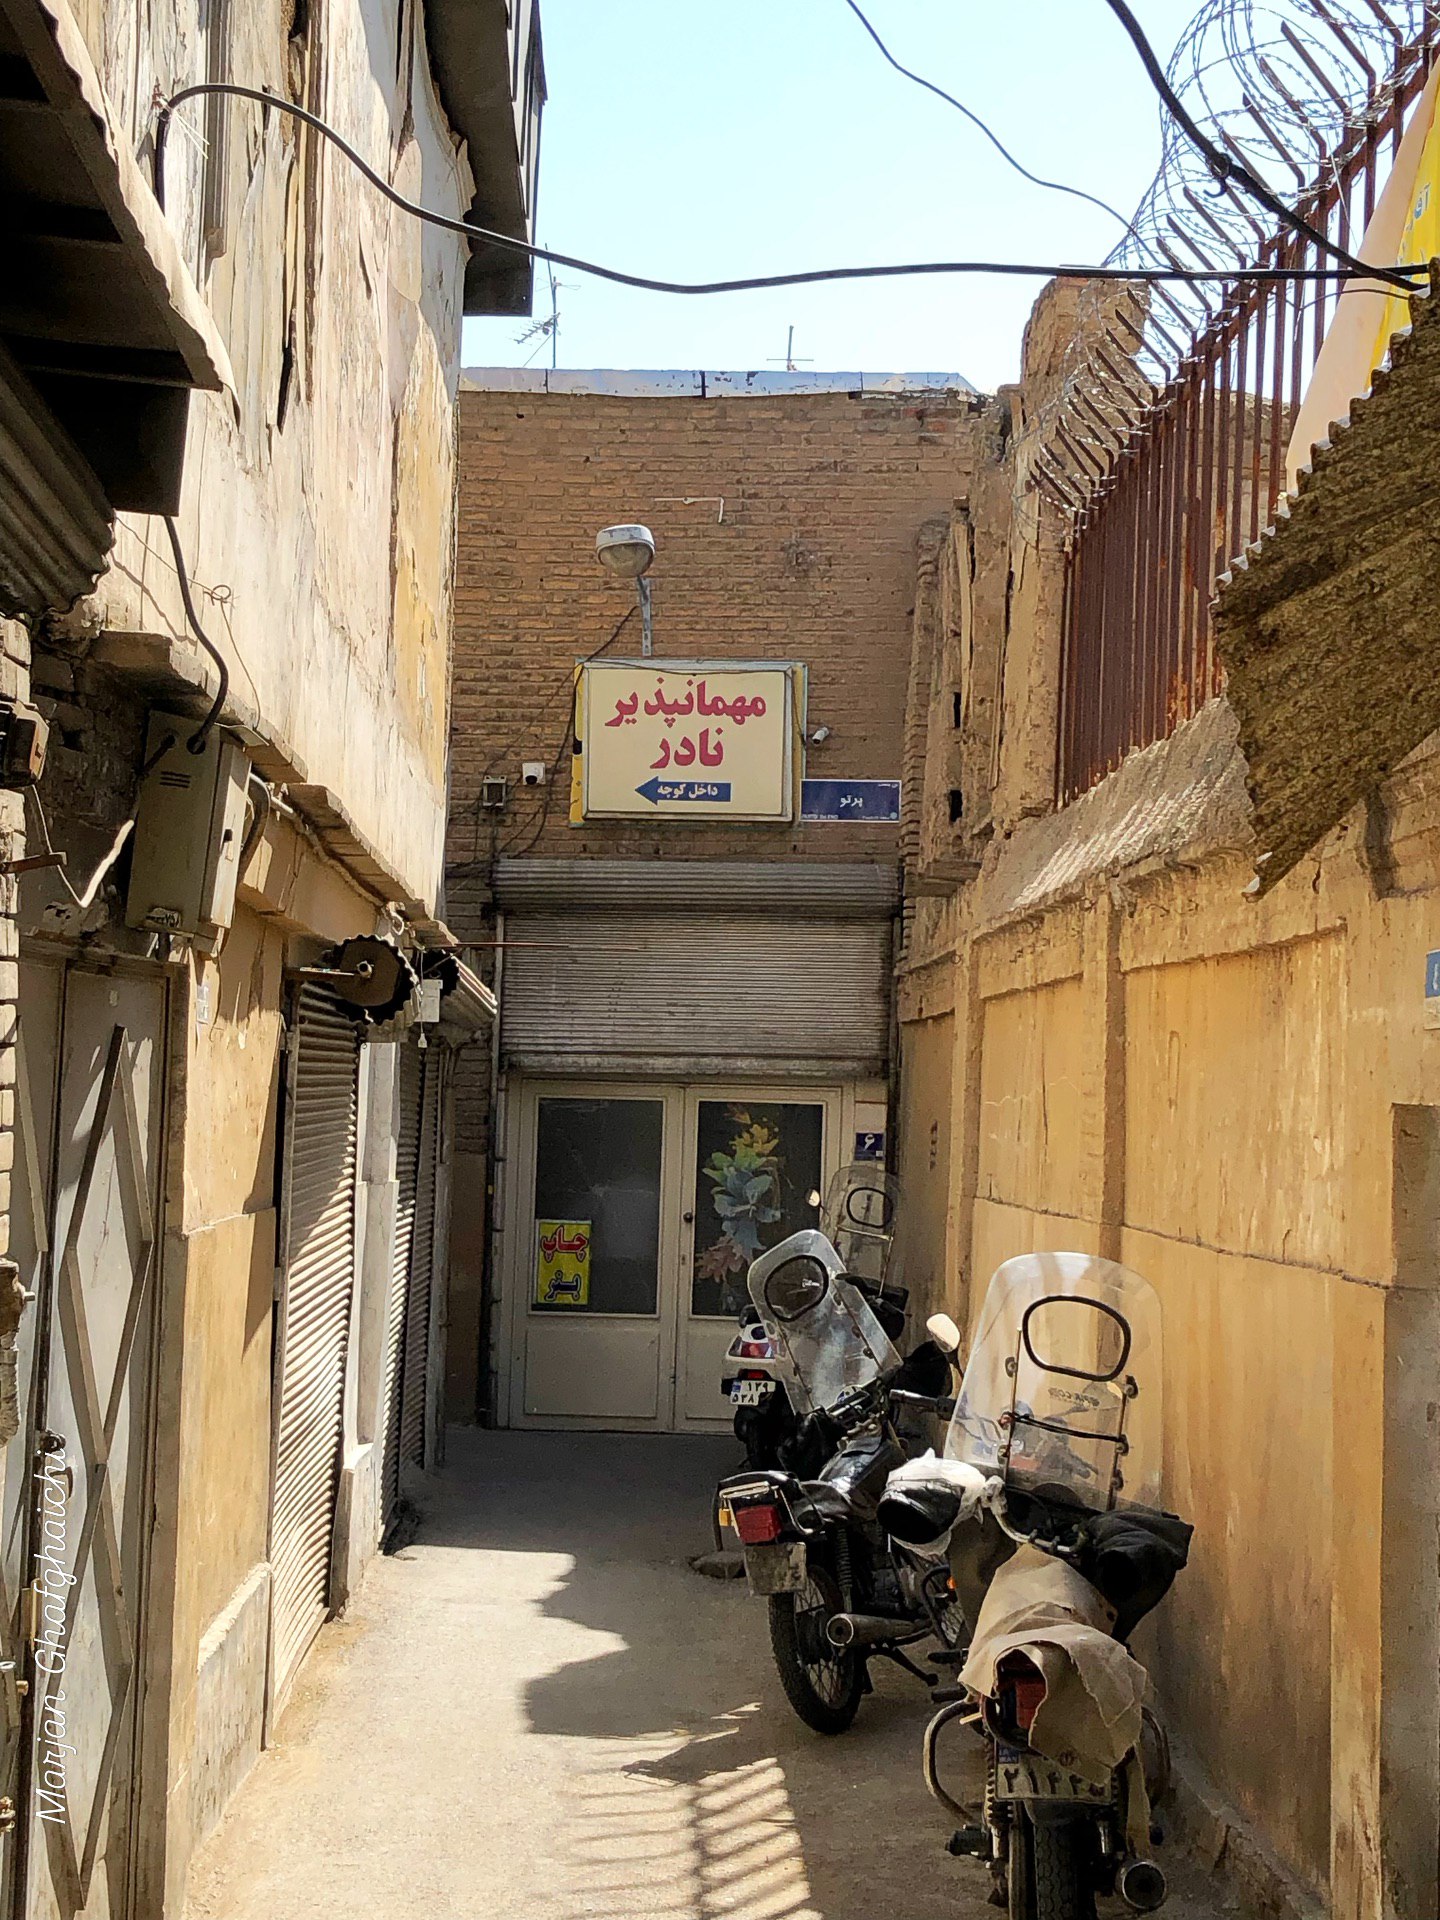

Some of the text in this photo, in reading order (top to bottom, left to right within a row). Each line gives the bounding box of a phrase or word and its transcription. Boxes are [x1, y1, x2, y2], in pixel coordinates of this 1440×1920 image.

[604, 676, 767, 728] مهمانپذیر
[650, 727, 725, 769] نادر
[656, 781, 718, 799] داخل کوچه
[840, 795, 863, 808] پرتو
[541, 1225, 589, 1263] چاپ
[544, 1270, 582, 1301] بنر
